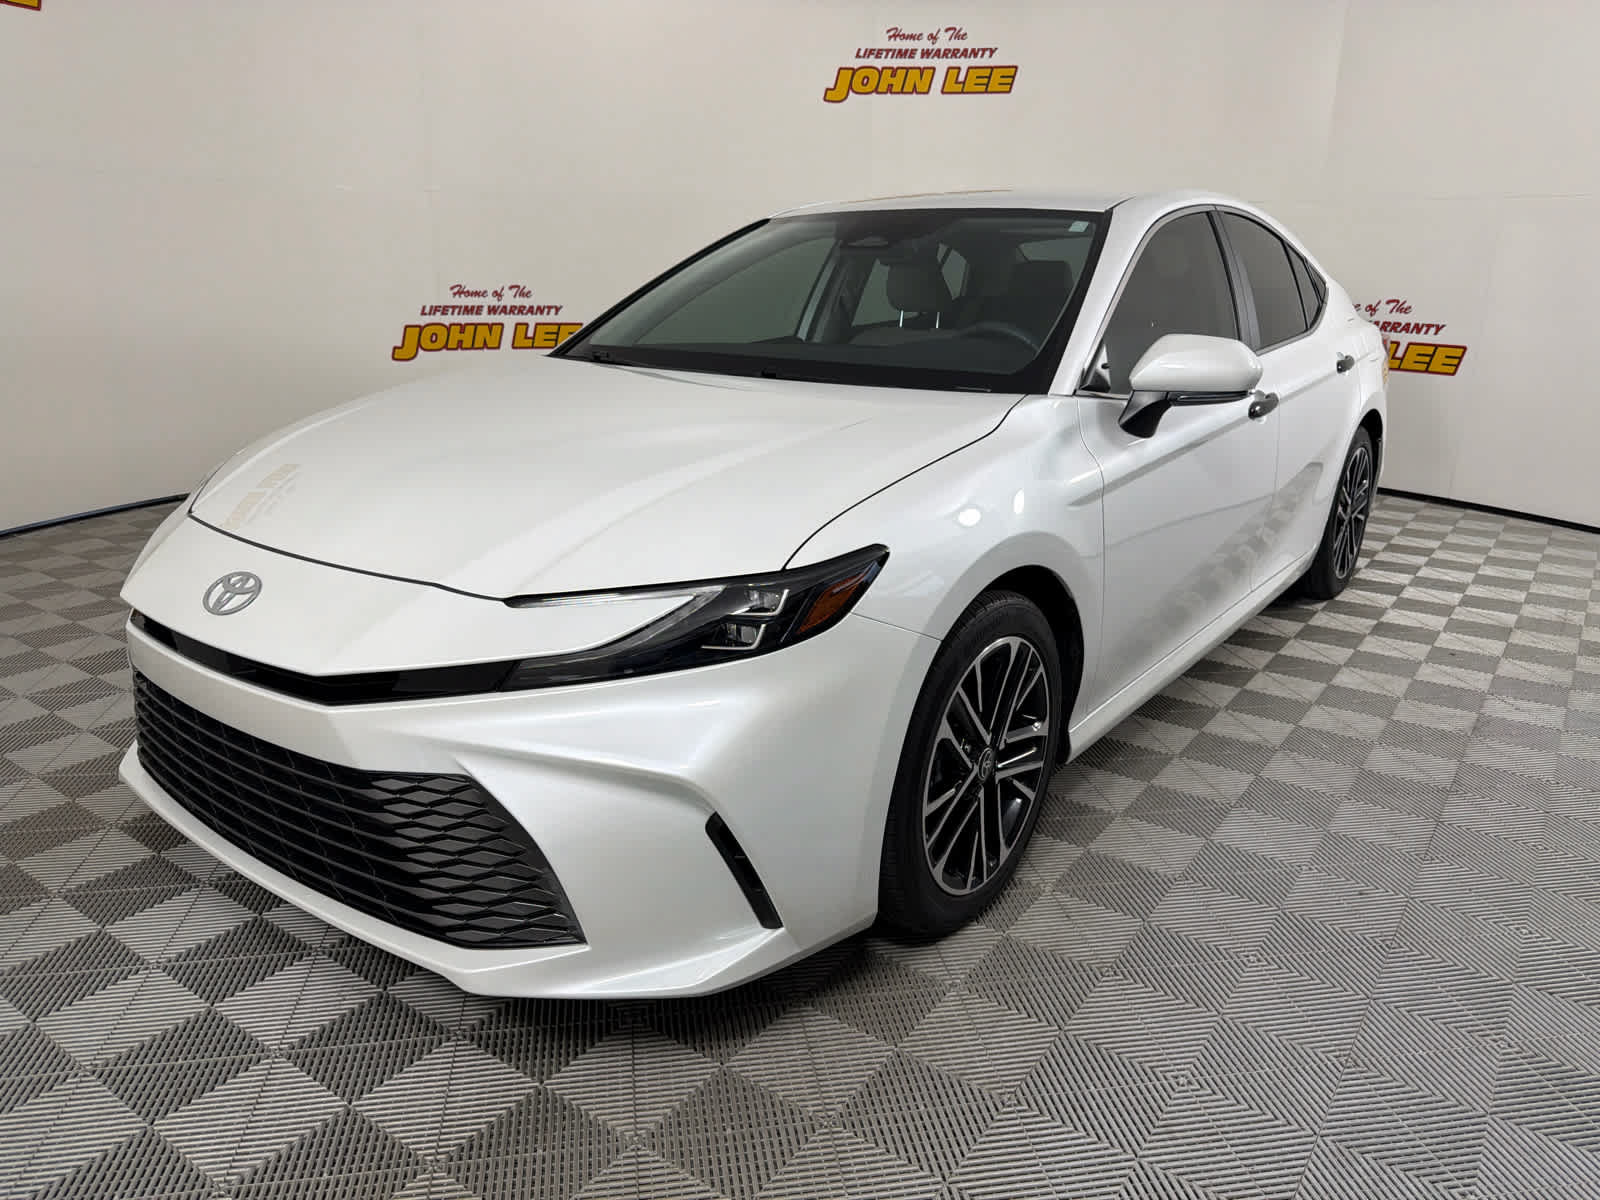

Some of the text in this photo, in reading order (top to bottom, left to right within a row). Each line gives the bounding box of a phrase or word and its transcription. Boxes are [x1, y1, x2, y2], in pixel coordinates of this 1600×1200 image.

[886, 27, 968, 45] Home of The
[855, 48, 998, 59] LIFETIME WARRANTY
[823, 65, 1018, 103] JOHN LEE
[450, 284, 532, 302] Home of The
[420, 305, 563, 316] LIFETIME WARRANTY
[1365, 300, 1381, 317] of
[1386, 299, 1412, 314] The
[392, 322, 504, 361] JOHN
[1388, 340, 1467, 376] LEE
